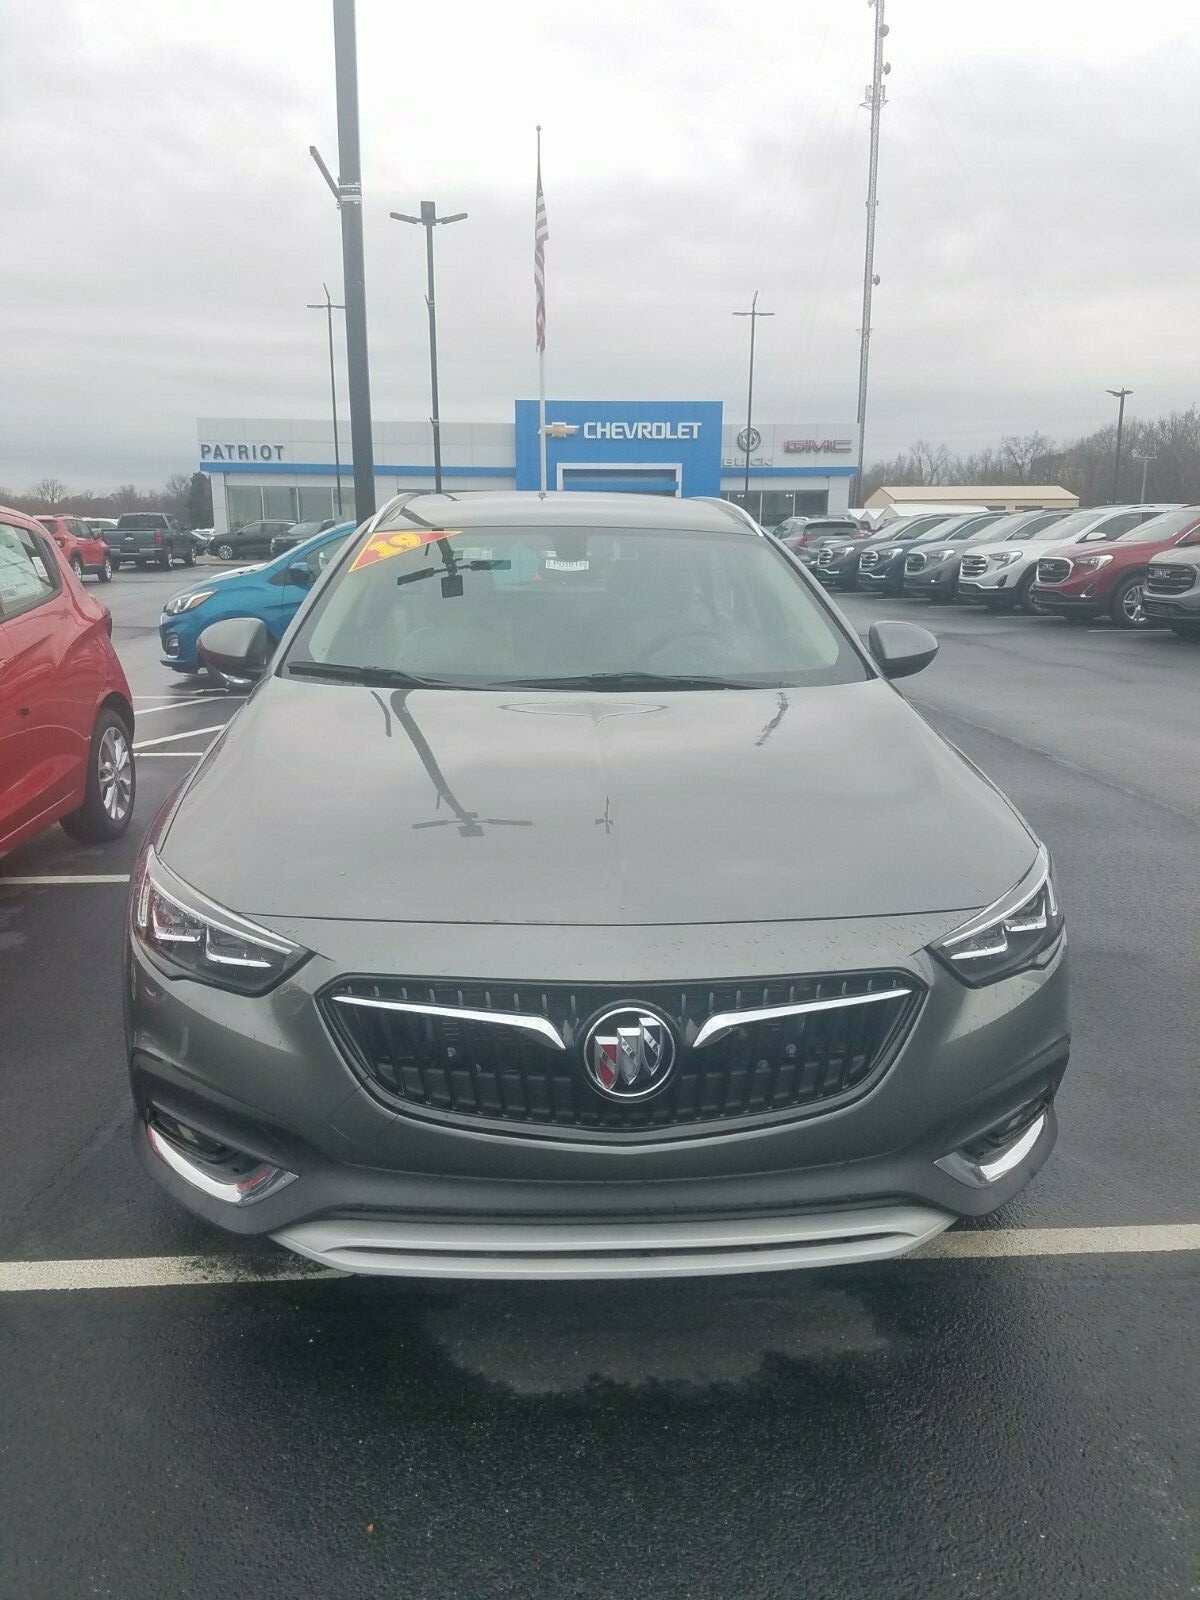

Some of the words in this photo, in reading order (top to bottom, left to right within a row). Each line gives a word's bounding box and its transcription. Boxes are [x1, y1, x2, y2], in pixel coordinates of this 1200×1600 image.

[583, 421, 703, 439] CHEVROLET
[200, 443, 285, 461] PATRIOT
[783, 439, 853, 454] GMC
[722, 456, 774, 467] BUCK
